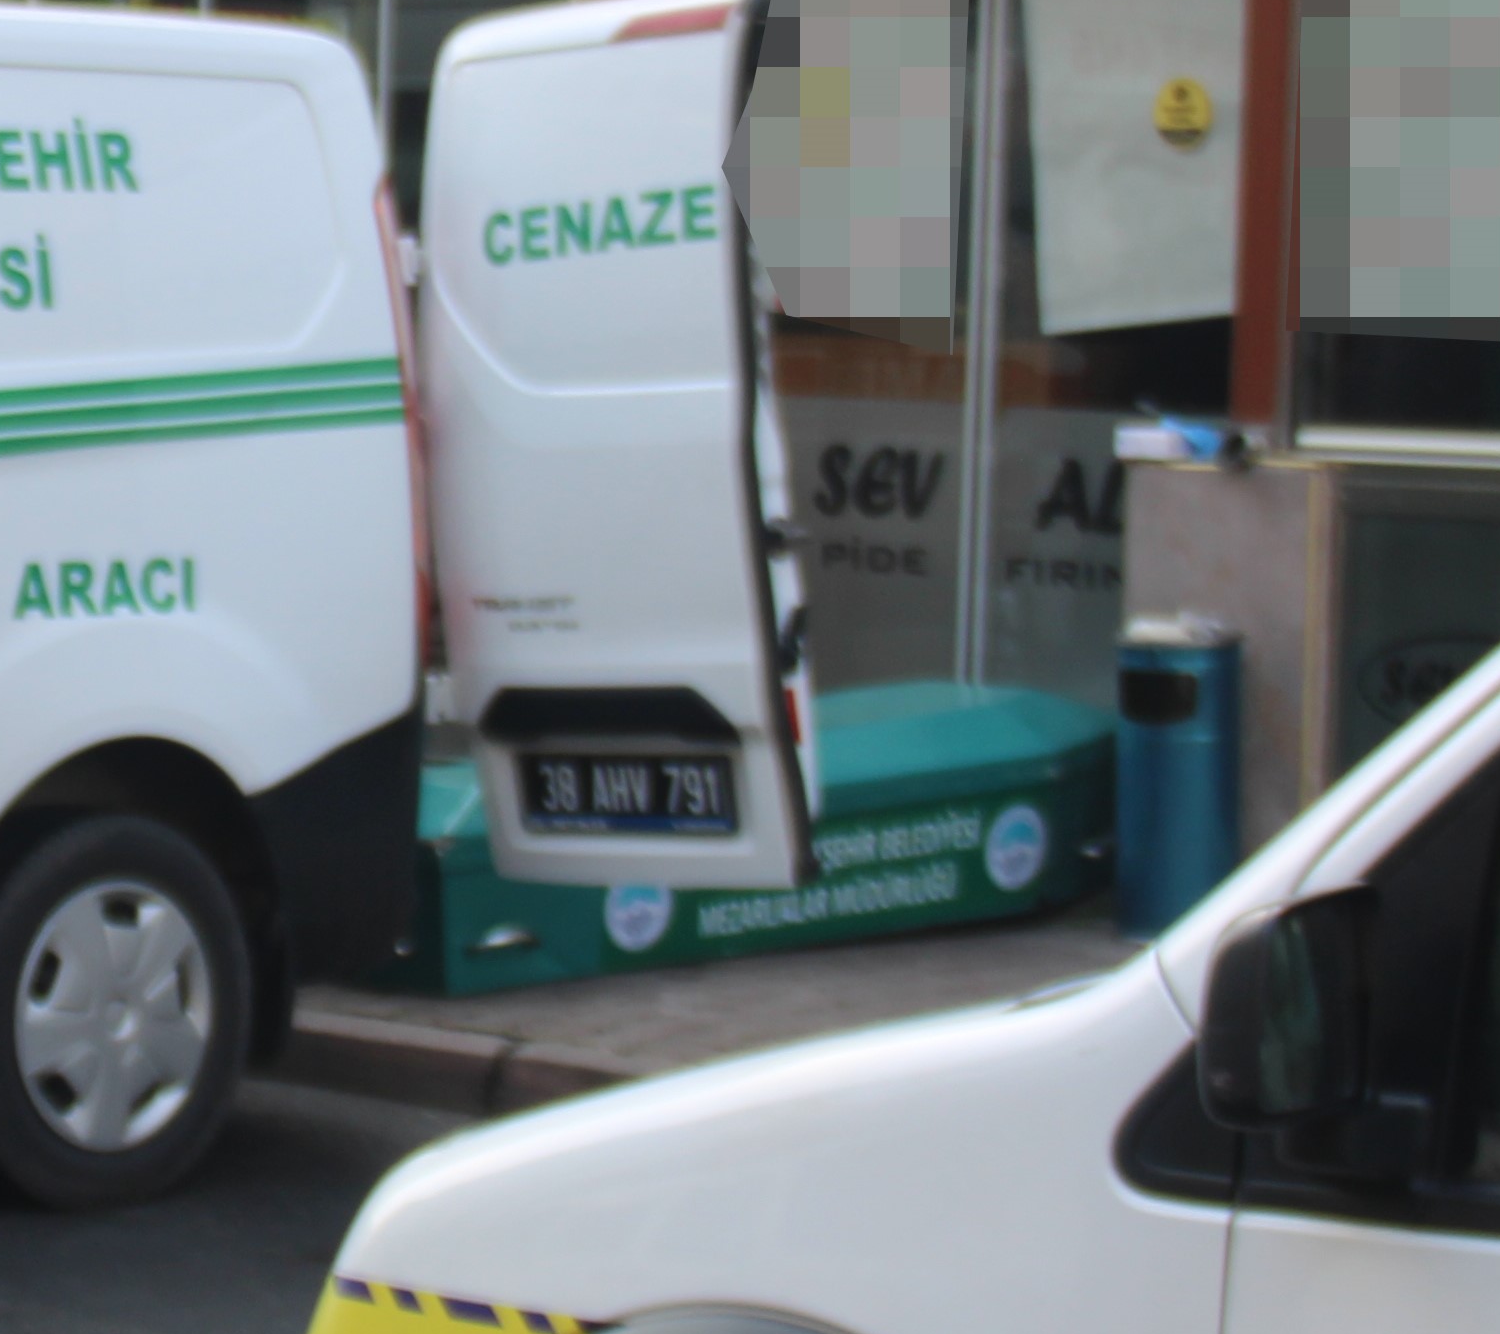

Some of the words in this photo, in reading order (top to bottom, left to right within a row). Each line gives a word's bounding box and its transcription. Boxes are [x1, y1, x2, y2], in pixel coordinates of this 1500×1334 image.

[482, 183, 719, 267] CENAZE
[13, 557, 199, 621] ARACI
[539, 764, 580, 814] 38
[592, 764, 651, 814] AHV
[662, 764, 720, 816] 791
